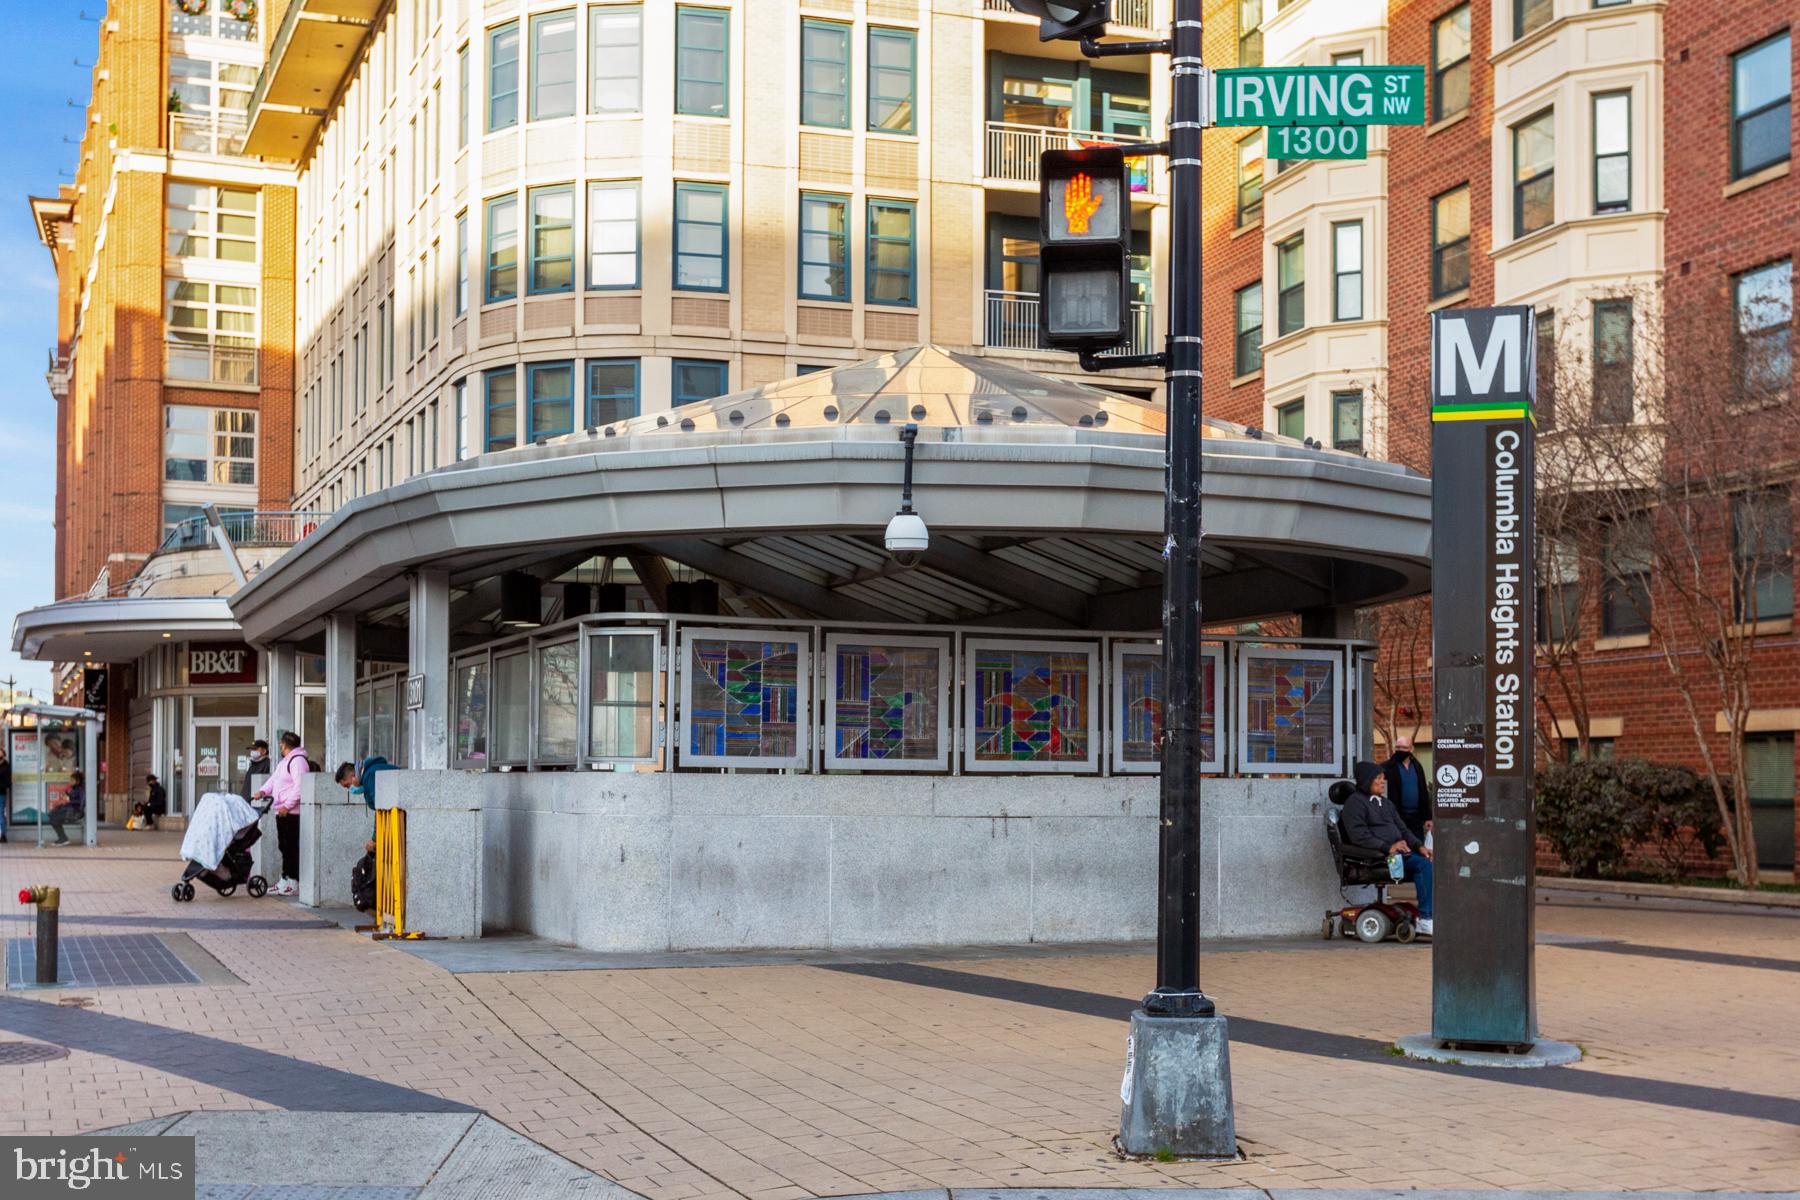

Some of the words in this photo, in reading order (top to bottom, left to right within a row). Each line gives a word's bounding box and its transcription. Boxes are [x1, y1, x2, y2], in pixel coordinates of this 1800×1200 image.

[1224, 73, 1373, 118] IRVING
[1384, 75, 1411, 94] ST
[1383, 96, 1411, 115] NW
[1277, 126, 1359, 155] 1300
[1440, 314, 1521, 396] M
[1495, 430, 1520, 556] Columbia
[1491, 563, 1520, 665] Heights
[190, 650, 244, 674] BB&T
[1495, 673, 1520, 770] Station
